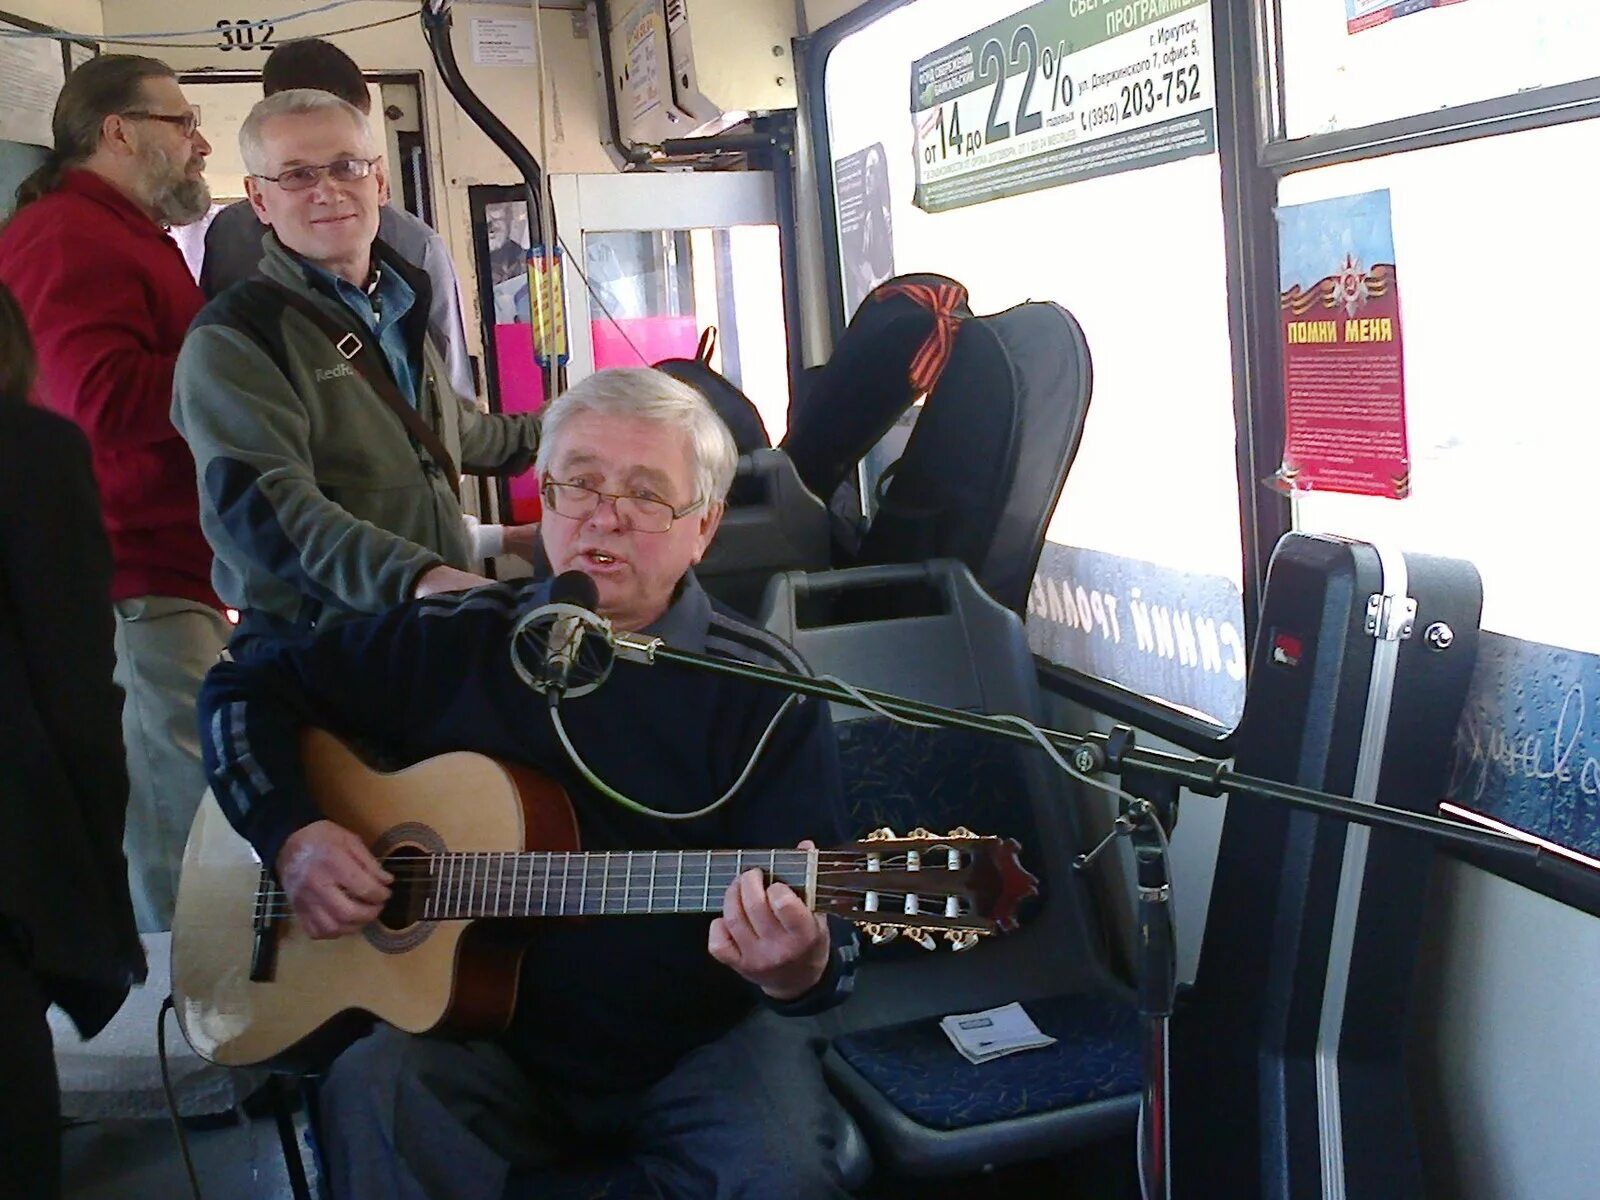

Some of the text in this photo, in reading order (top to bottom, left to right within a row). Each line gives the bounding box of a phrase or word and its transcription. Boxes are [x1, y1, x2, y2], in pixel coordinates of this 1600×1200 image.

[217, 19, 275, 51] 302
[1157, 19, 1199, 45] Иркутск,
[979, 24, 1074, 145] 22%
[1091, 59, 1150, 91] Дзержинского
[1163, 46, 1189, 67] офис
[1191, 39, 1200, 57] 5,
[1088, 64, 1201, 131] (3952) 203-752
[935, 101, 963, 159] 14
[1287, 318, 1392, 344] ПОМНИ МЕНЯ
